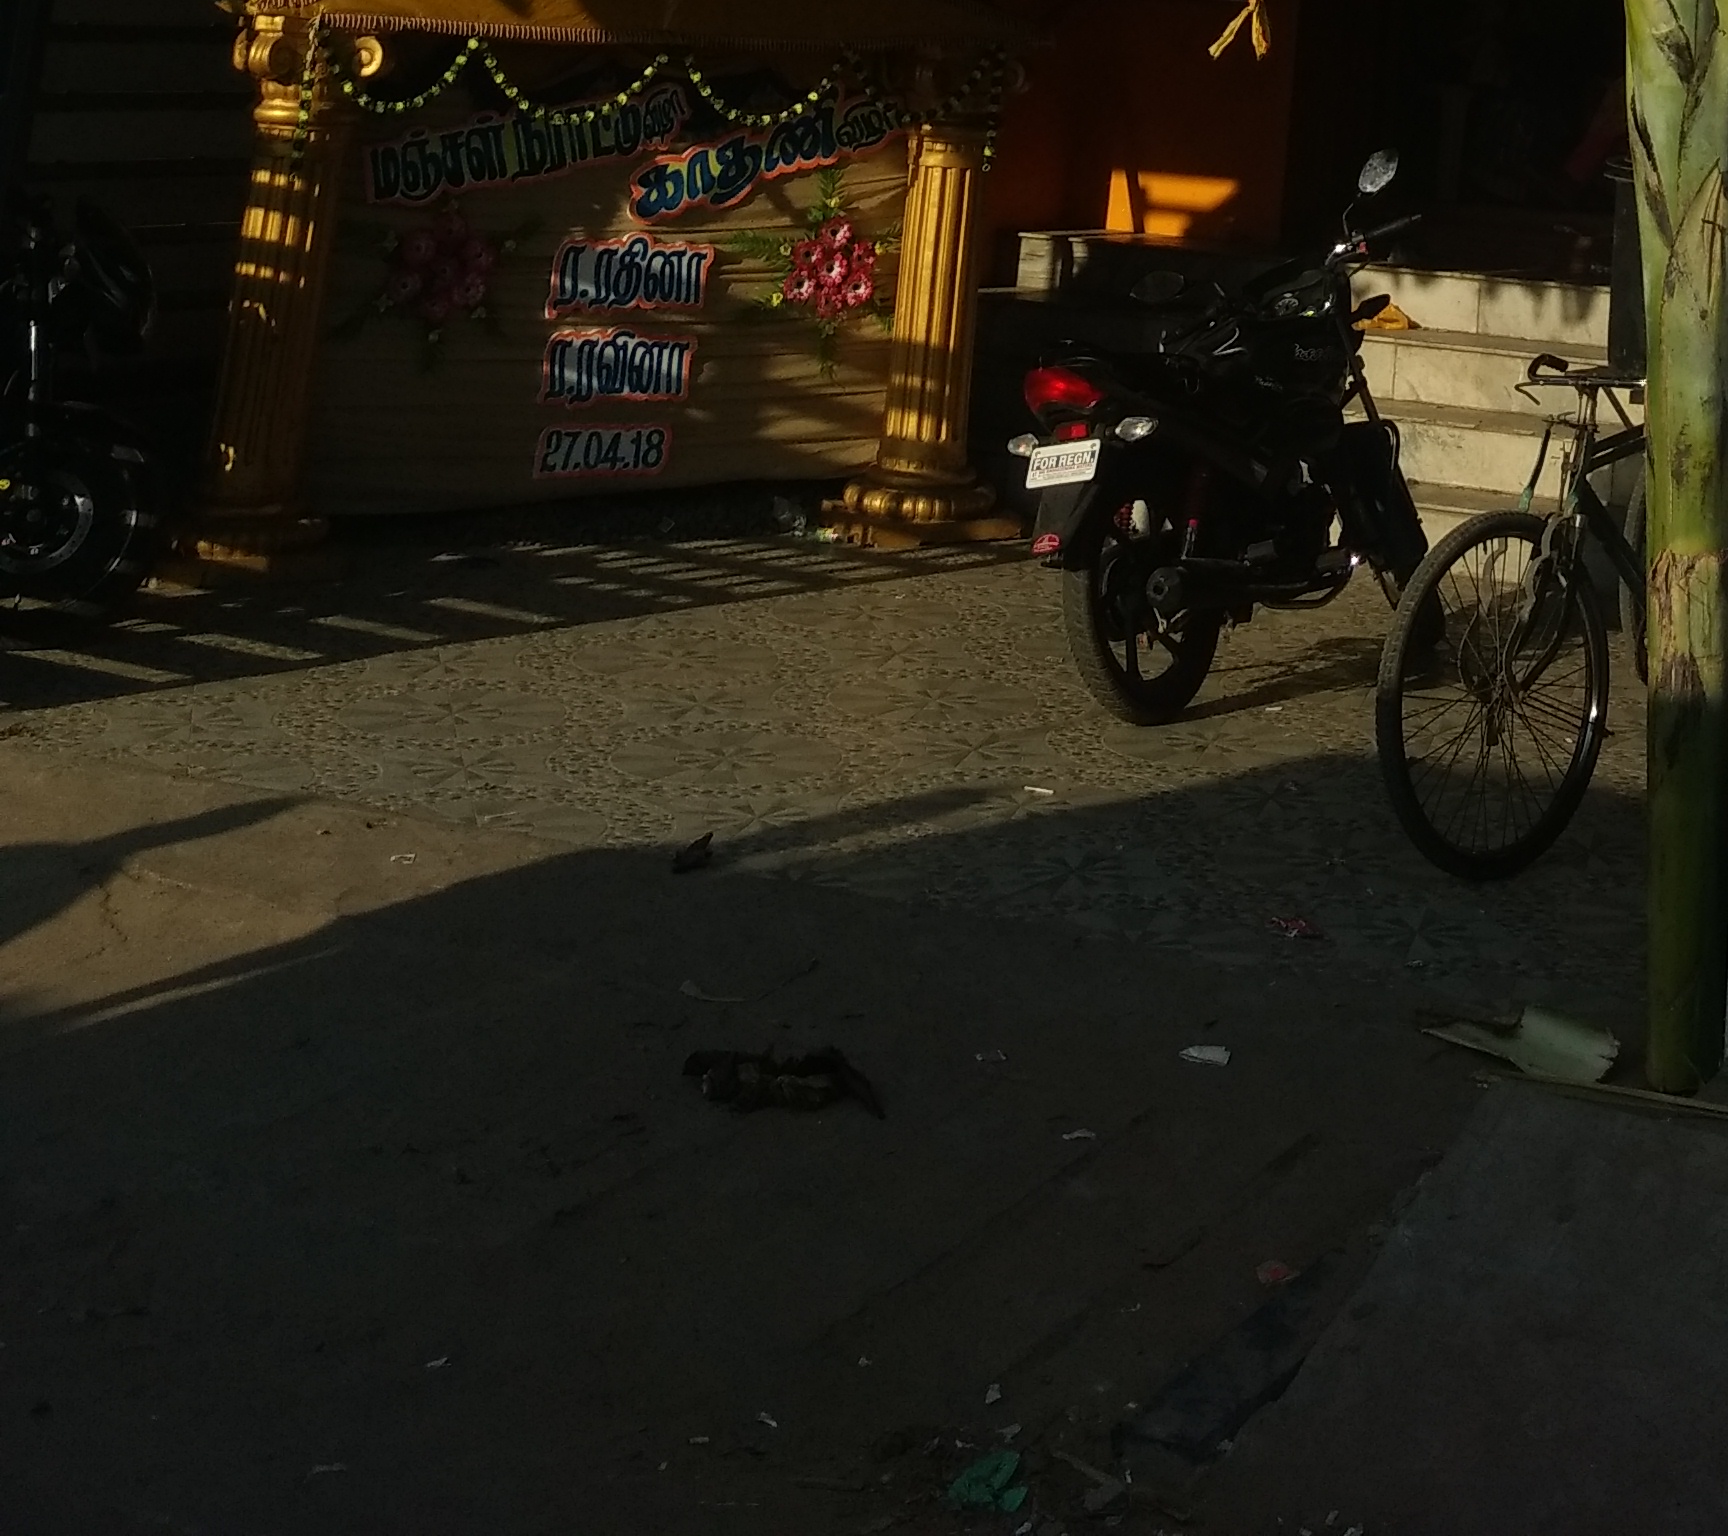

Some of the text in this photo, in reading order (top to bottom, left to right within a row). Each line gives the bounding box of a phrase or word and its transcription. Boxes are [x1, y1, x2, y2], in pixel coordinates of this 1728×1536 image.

[370, 115, 507, 200] மஞ்சள்
[637, 96, 838, 217] காதணி
[541, 429, 665, 472] 27.04.18
[1033, 451, 1094, 471] FOR REGN.
